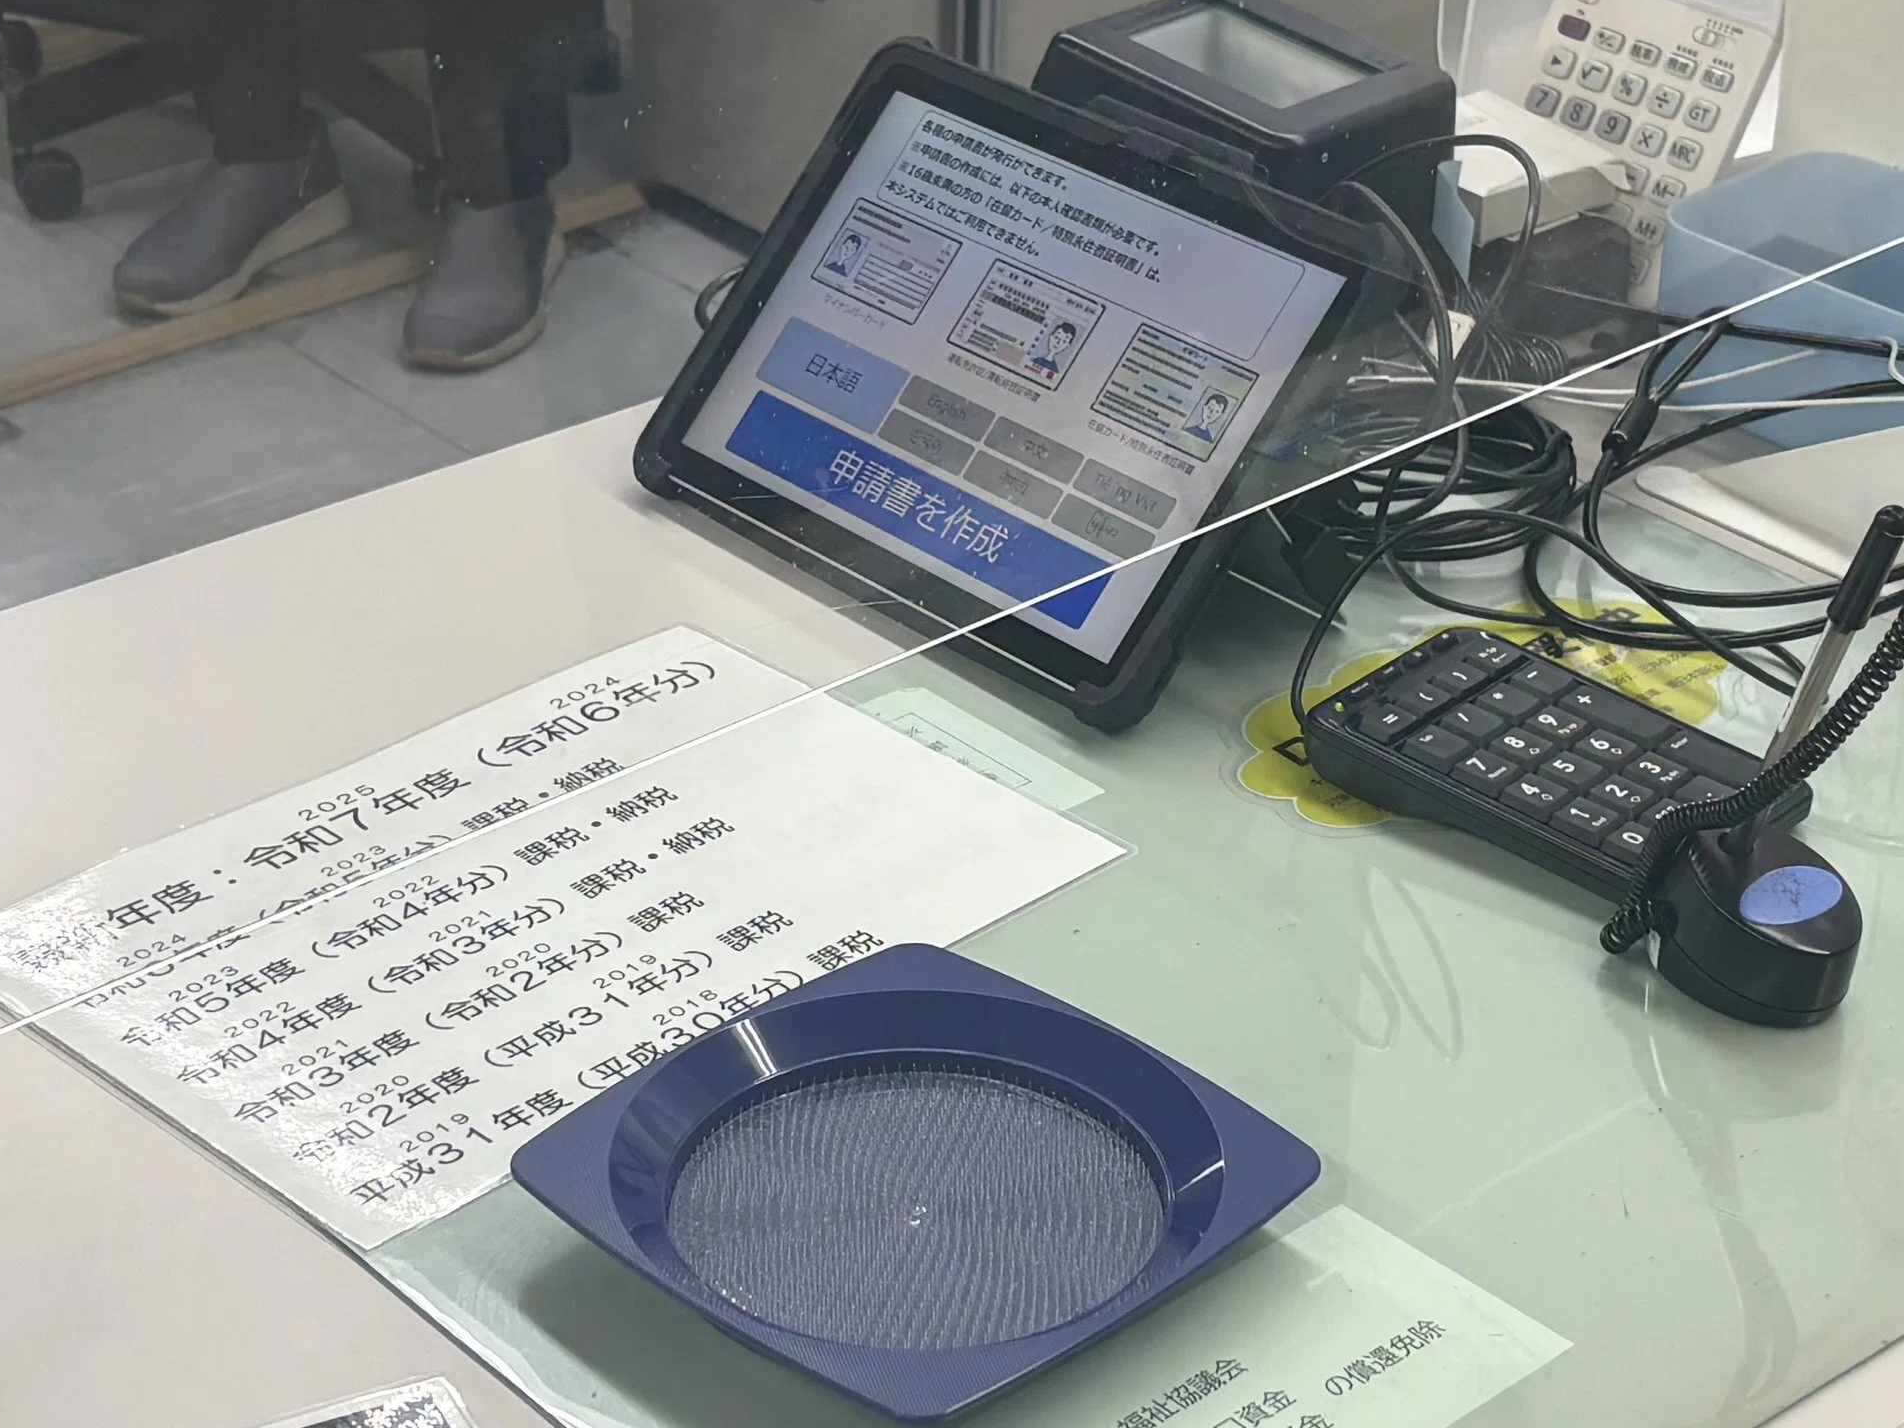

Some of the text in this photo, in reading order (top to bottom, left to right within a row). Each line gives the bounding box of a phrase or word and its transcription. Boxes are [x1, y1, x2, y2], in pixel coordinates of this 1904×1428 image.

[1536, 89, 1550, 110] 7
[1569, 103, 1582, 123] 8
[1689, 104, 1710, 124] GT
[1603, 115, 1617, 137] 9
[804, 353, 864, 395] 日本語
[926, 392, 968, 422] English
[827, 447, 1012, 566] 申請書を作成
[550, 675, 621, 710] 2024
[1537, 712, 1558, 727] 9
[1503, 735, 1525, 751] 8
[1590, 735, 1610, 751] 6
[1466, 757, 1488, 771] 7
[1553, 758, 1577, 773] 5
[1639, 760, 1662, 775] 3
[298, 783, 377, 823] 2025
[1521, 779, 1542, 796] 4
[1605, 783, 1629, 799] 2
[1568, 808, 1593, 820] 1
[1621, 830, 1645, 845] 0
[320, 845, 387, 879] 2023
[373, 874, 440, 909] 2022
[428, 910, 493, 943] 2021
[116, 933, 187, 968] 2024
[485, 941, 553, 979] 2020
[168, 965, 239, 1003] 2023
[592, 952, 660, 990] 2019
[224, 1000, 297, 1038] 2022
[651, 987, 719, 1027] 2018
[281, 1039, 349, 1077] 2021
[339, 1074, 411, 1117] 2020
[398, 1112, 471, 1155] 2019
[1324, 1318, 1447, 1399] の償還免除
